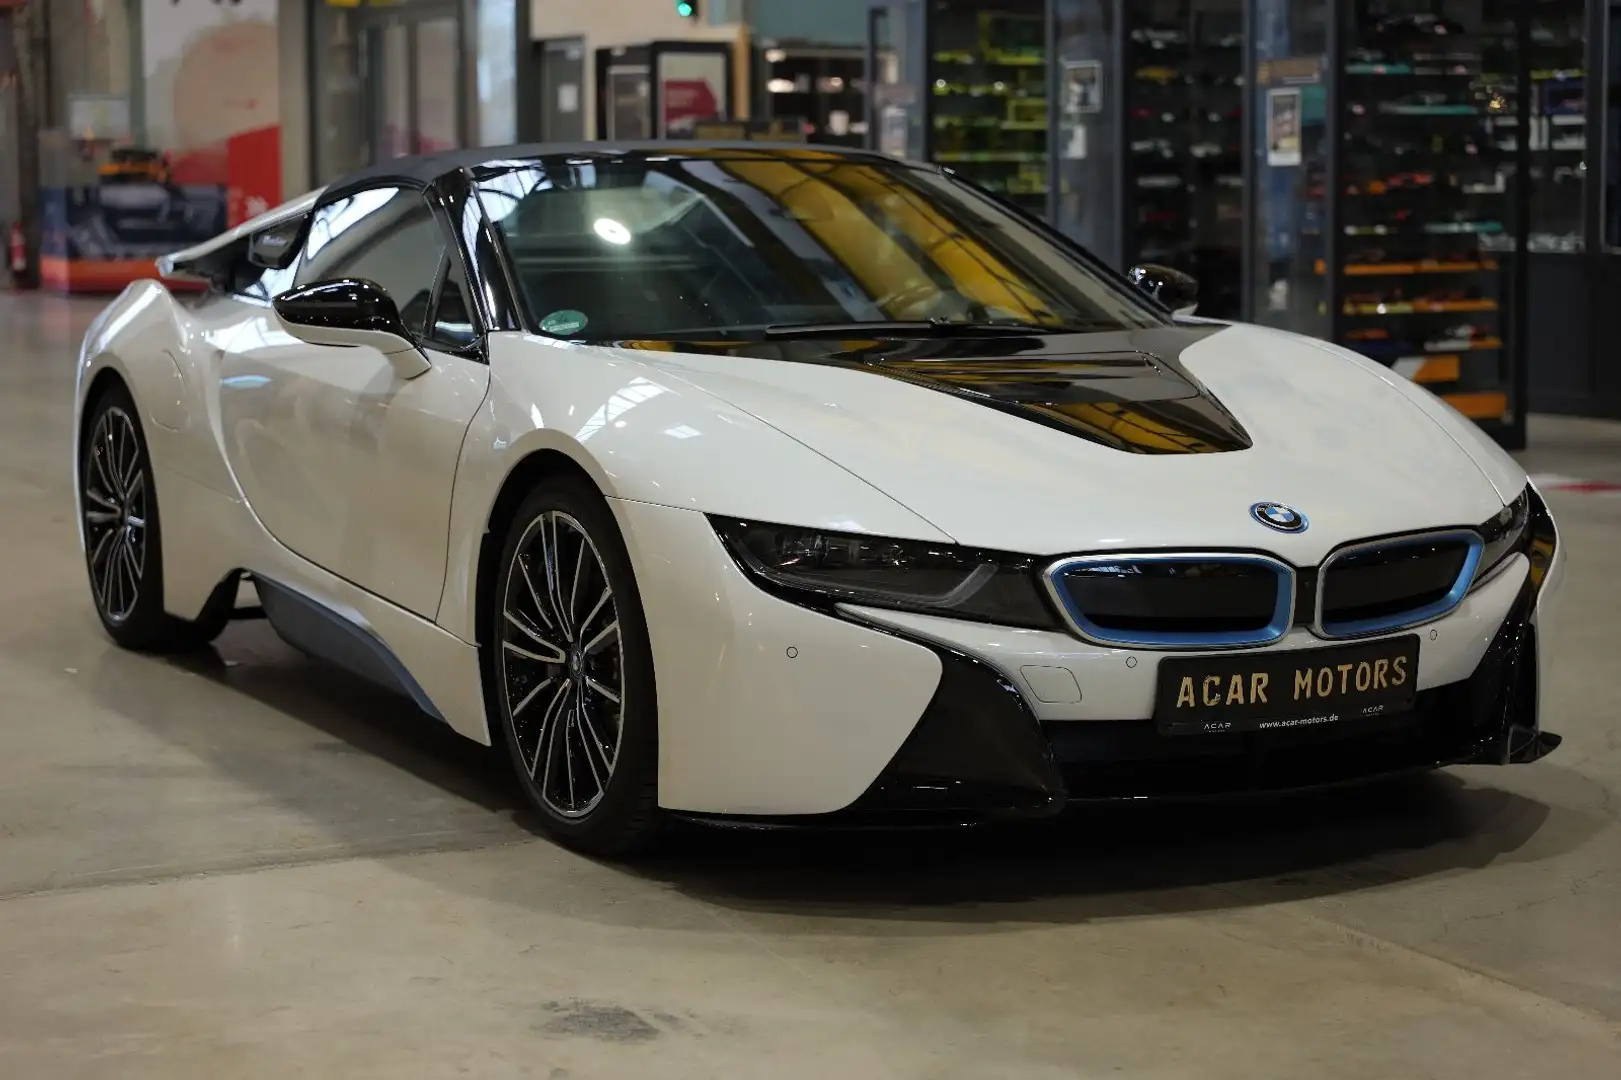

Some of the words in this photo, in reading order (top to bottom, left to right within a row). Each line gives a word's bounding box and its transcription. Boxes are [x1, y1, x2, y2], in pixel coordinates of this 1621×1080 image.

[1176, 672, 1269, 708] ACAR
[1293, 656, 1407, 700] MOTORS
[1362, 705, 1384, 714] ACAR
[1203, 722, 1231, 730] ACAR
[1259, 713, 1339, 728] www.acar-motors.de
